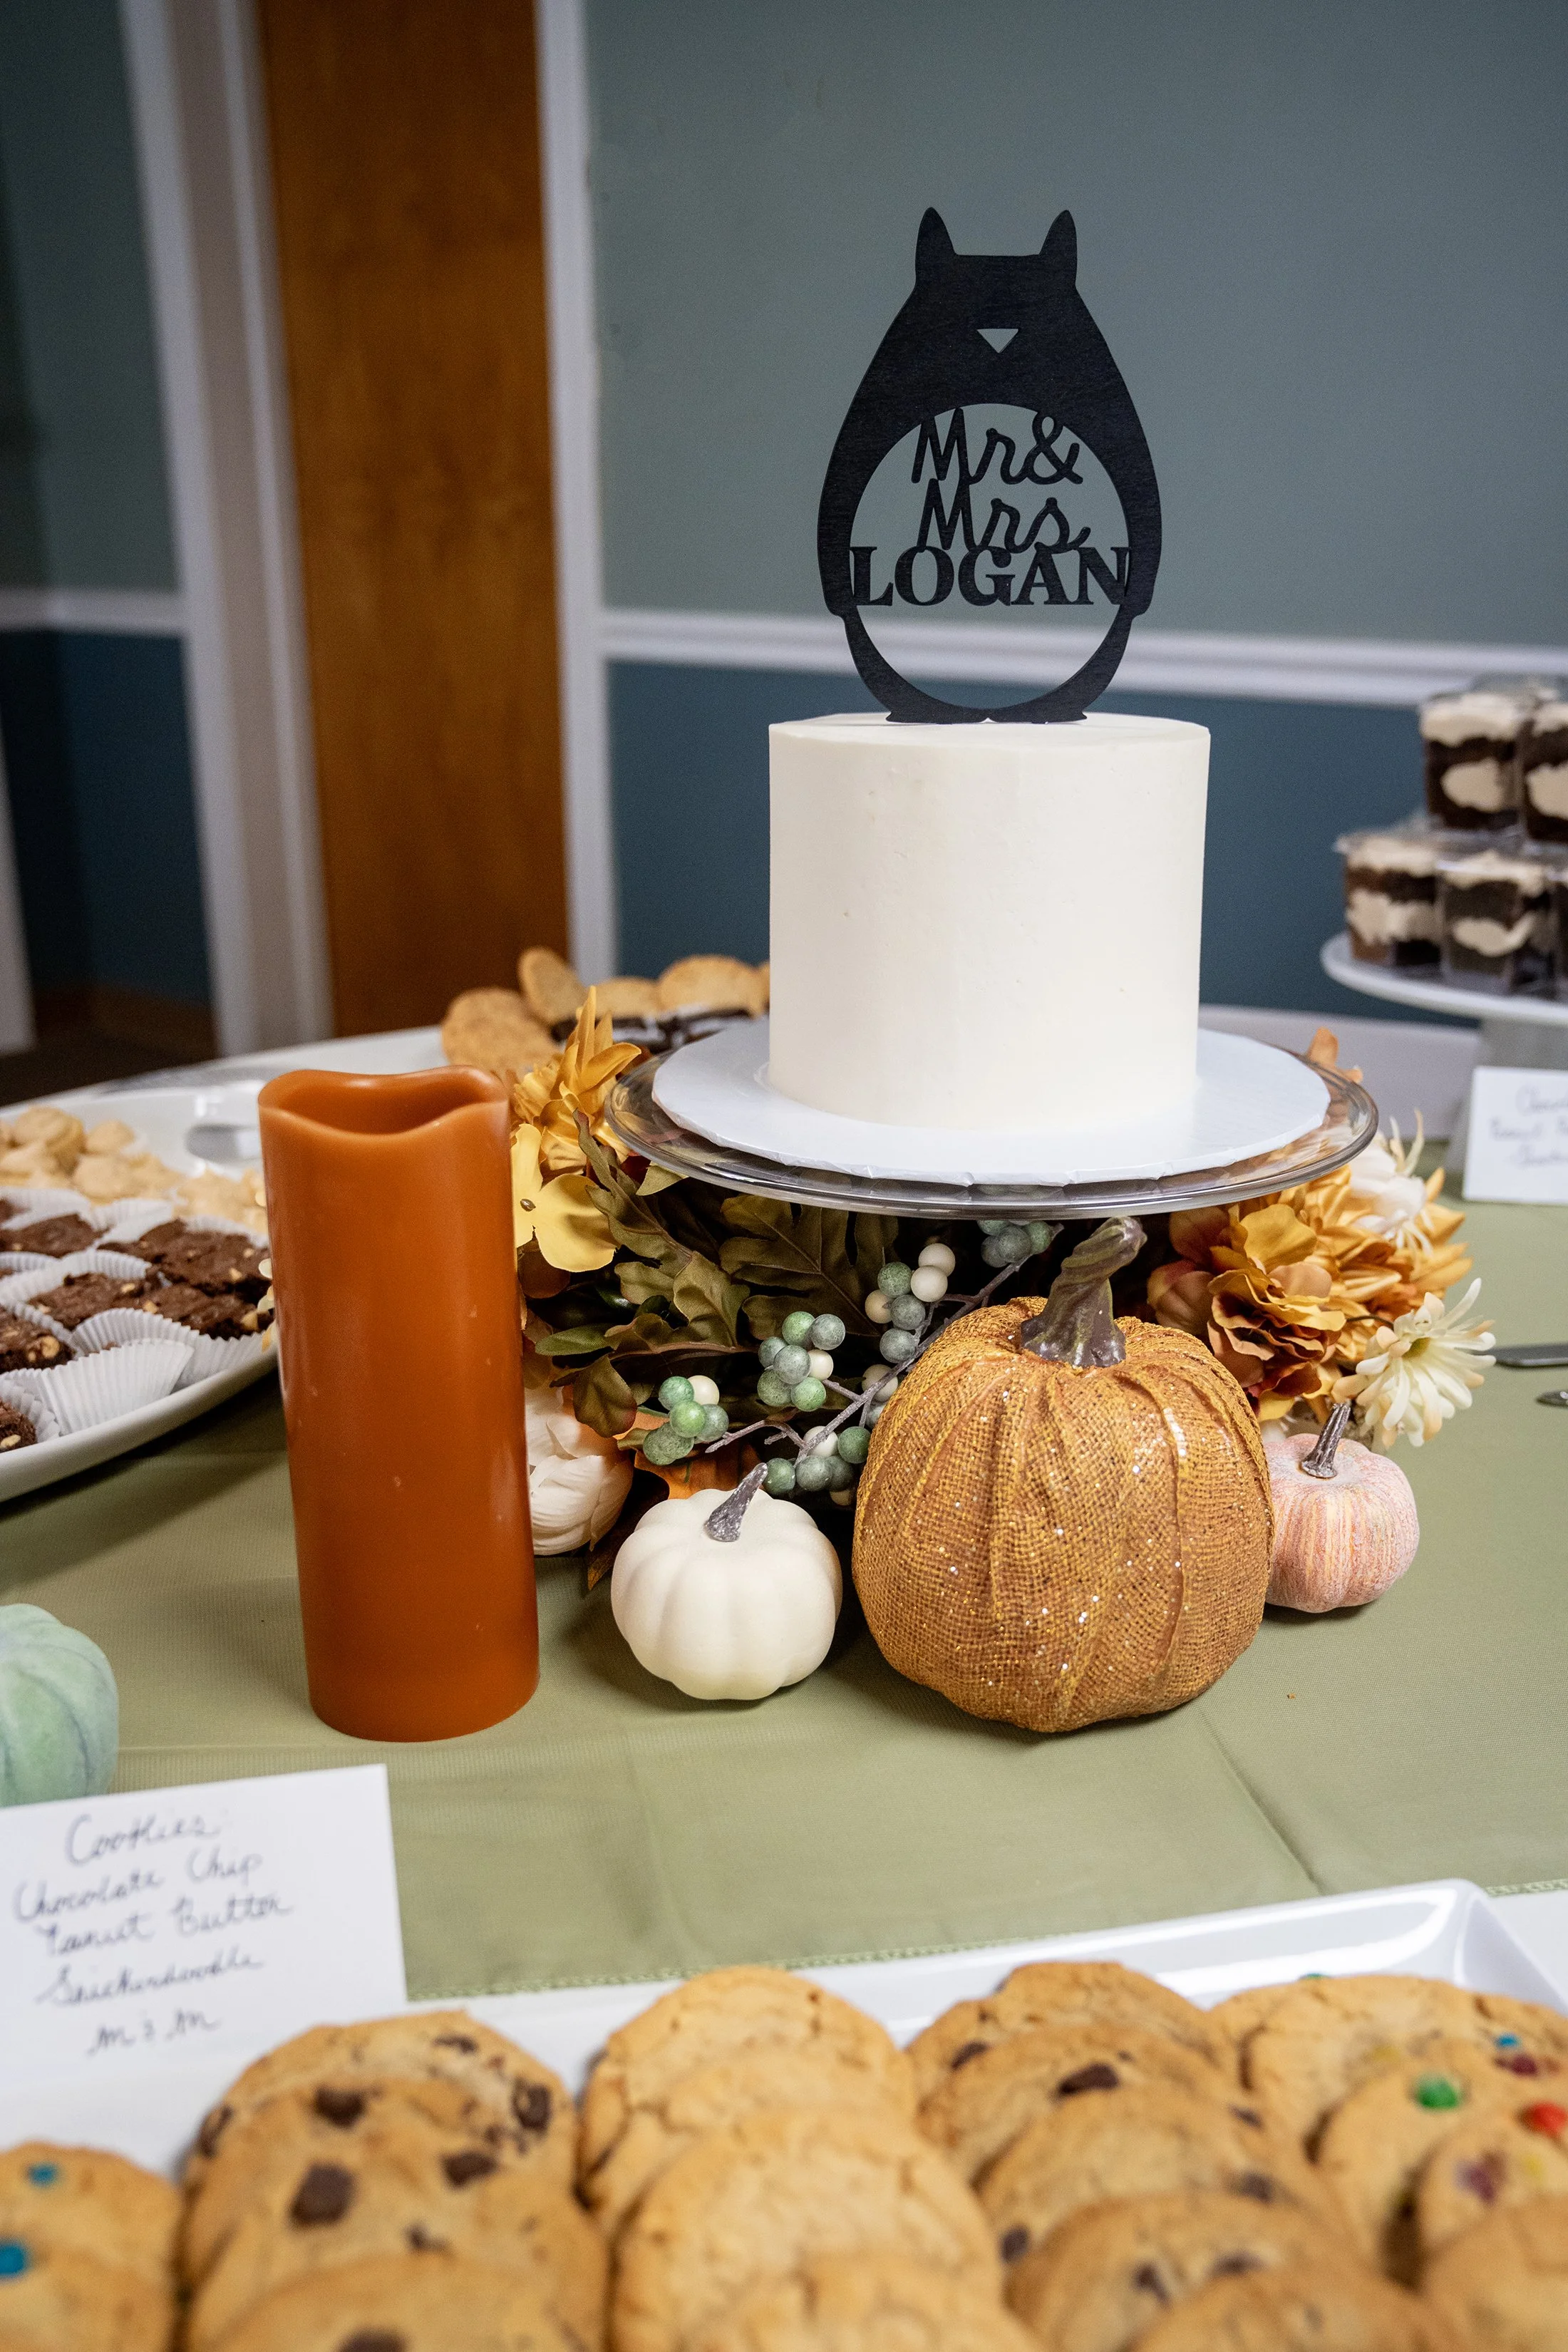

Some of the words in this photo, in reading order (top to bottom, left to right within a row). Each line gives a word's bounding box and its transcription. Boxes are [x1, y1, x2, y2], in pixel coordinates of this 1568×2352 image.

[917, 478, 1091, 554] Mrs
[849, 545, 1130, 607] LOGAN
[13, 1867, 165, 1923] Chocolate
[185, 1846, 264, 1885] Chip
[171, 1892, 295, 1937] Butter
